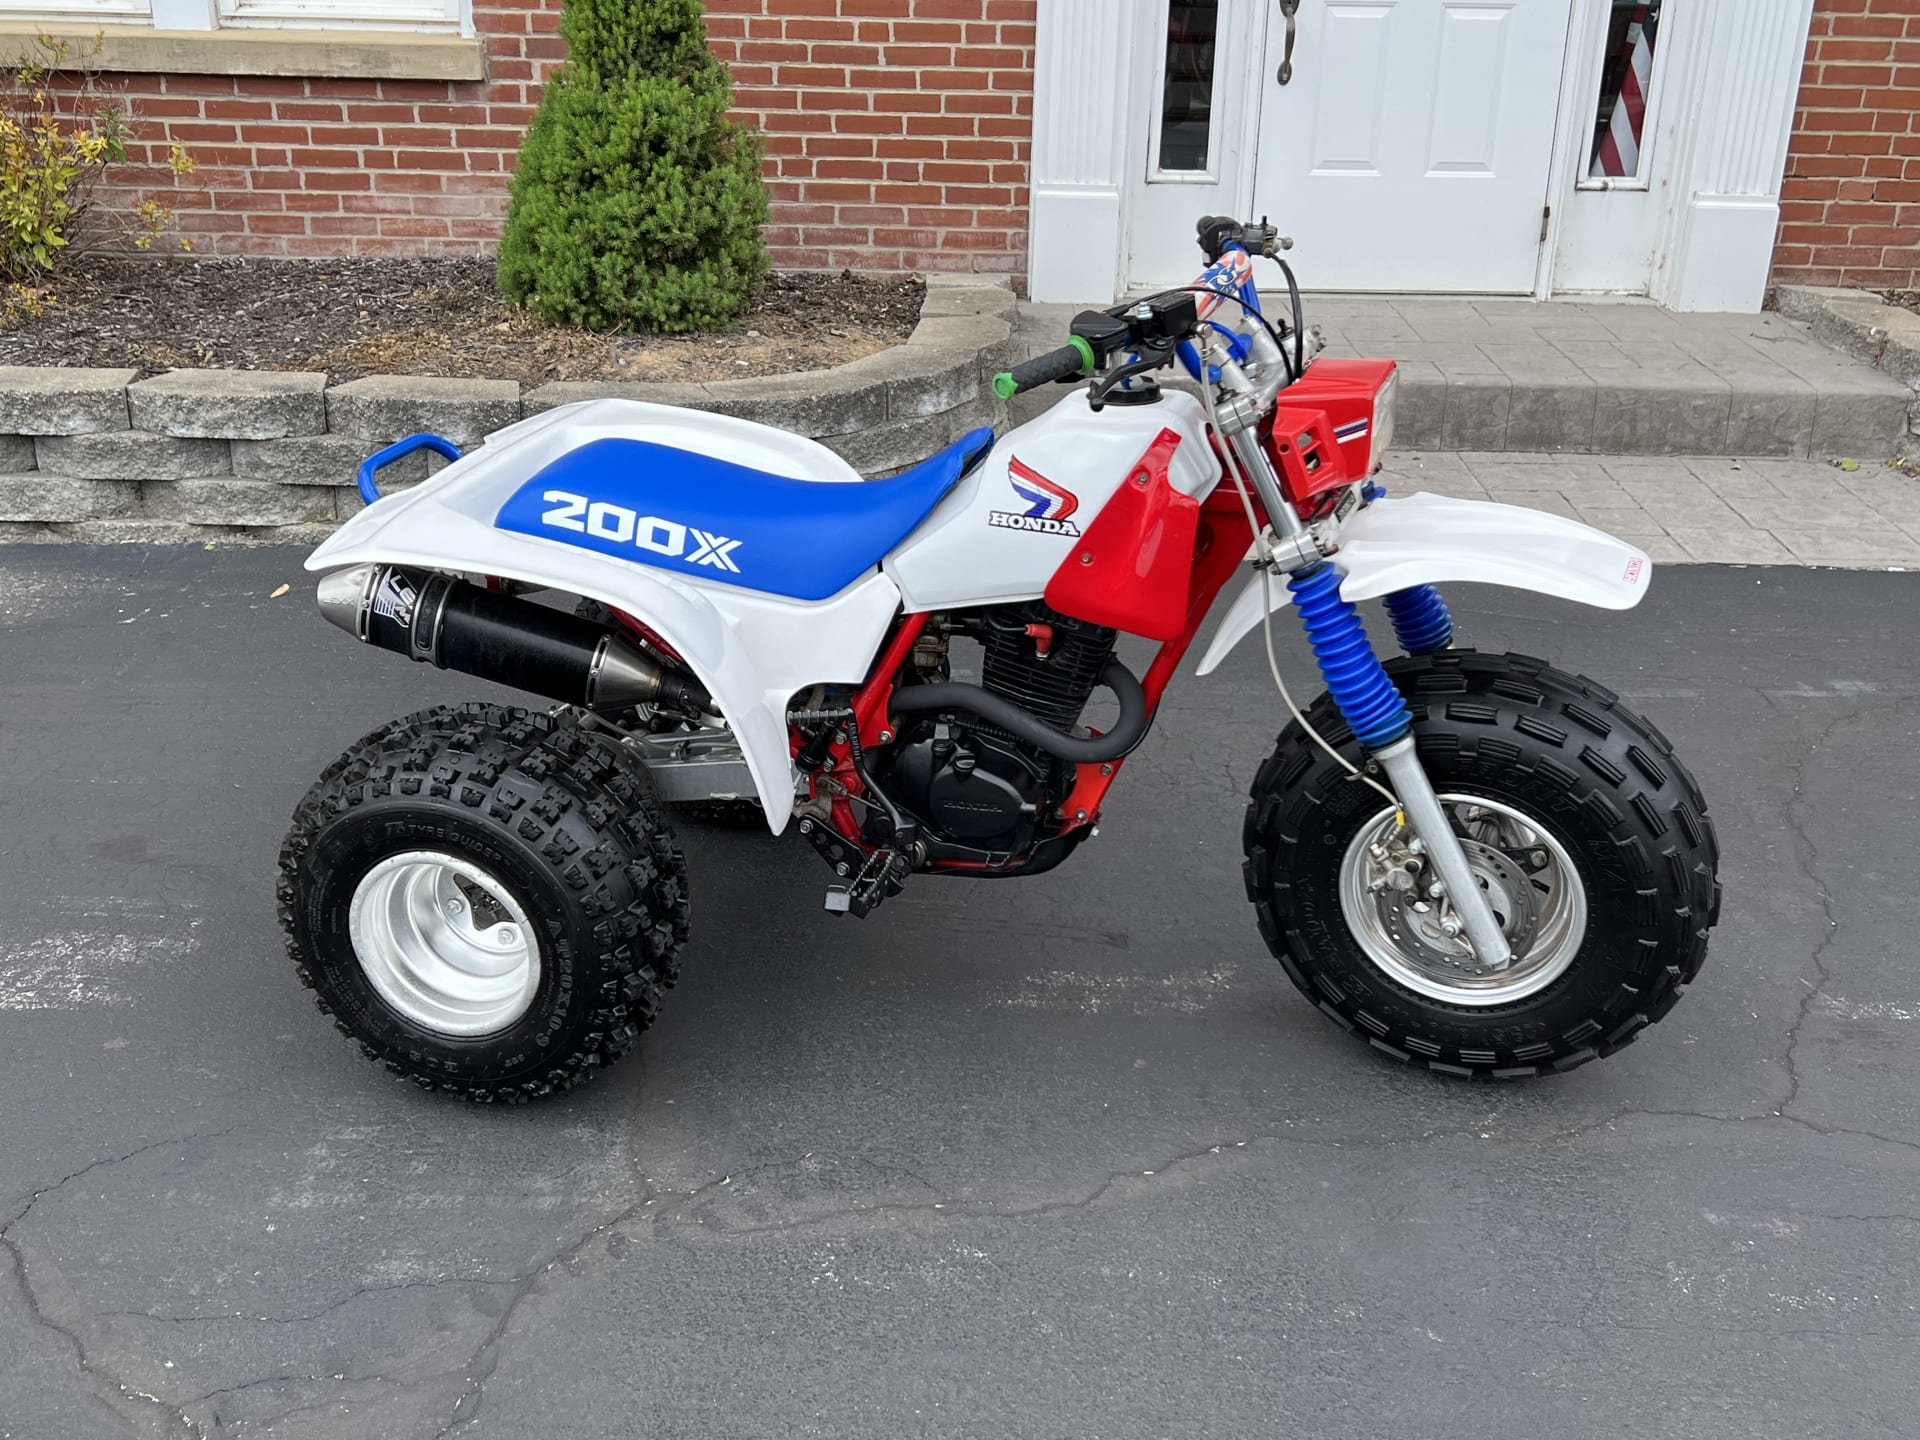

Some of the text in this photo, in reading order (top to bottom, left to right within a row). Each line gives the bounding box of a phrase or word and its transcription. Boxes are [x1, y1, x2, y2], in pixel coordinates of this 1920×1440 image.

[541, 490, 743, 573] 200X
[988, 510, 1081, 537] HONDA
[943, 799, 1004, 814] HONDA
